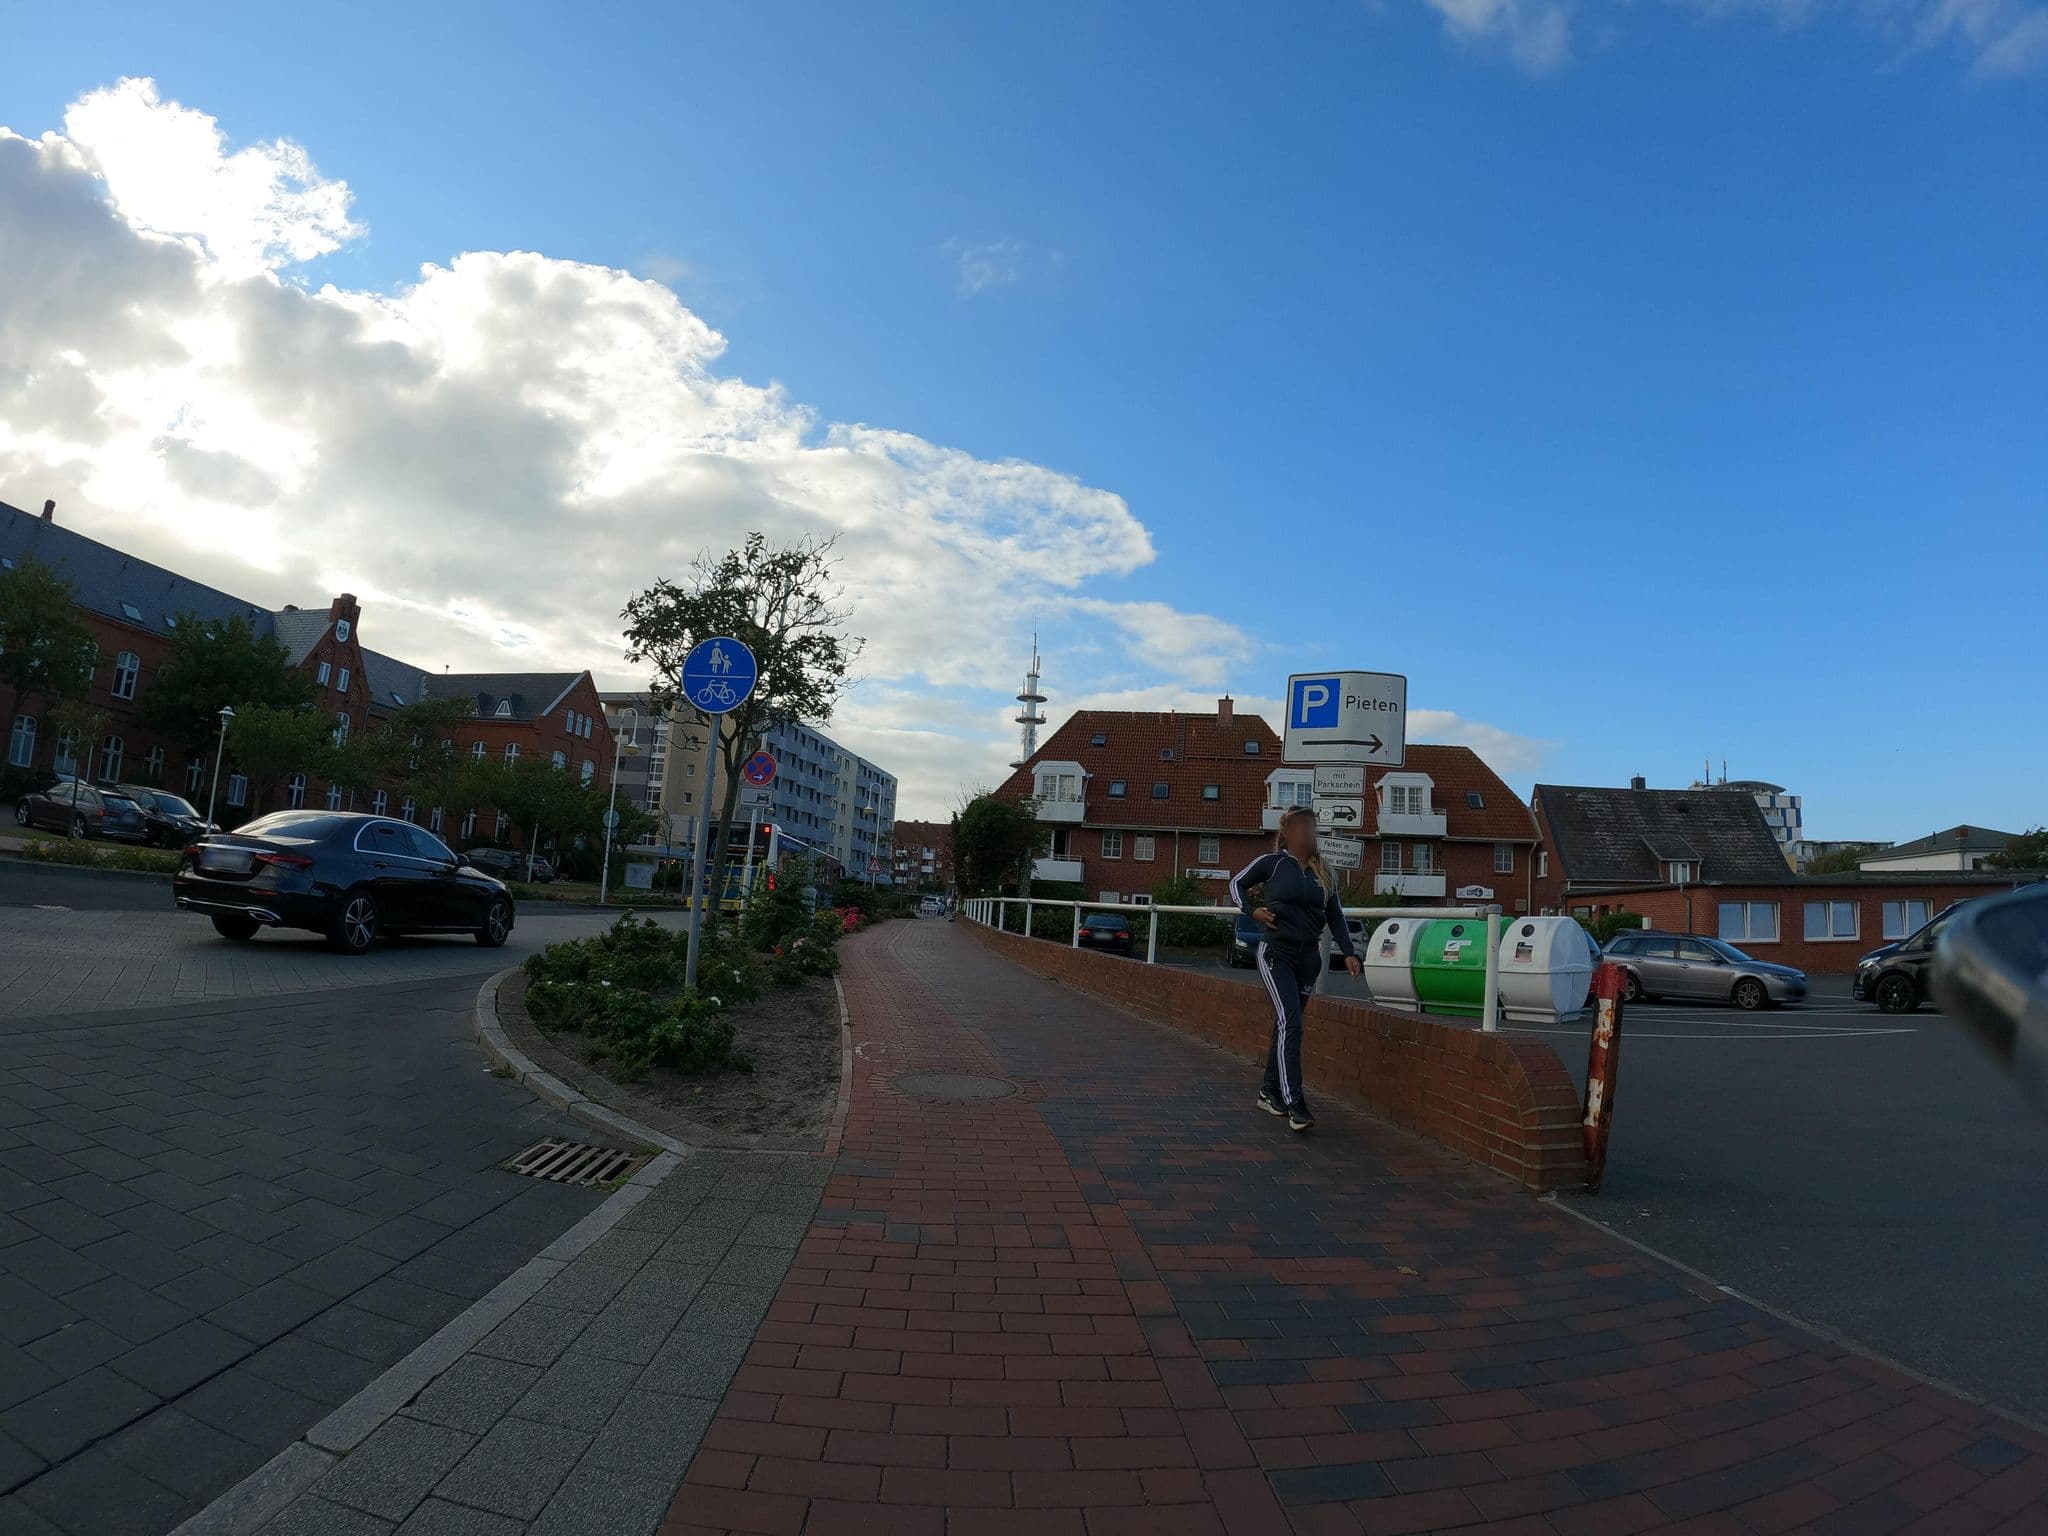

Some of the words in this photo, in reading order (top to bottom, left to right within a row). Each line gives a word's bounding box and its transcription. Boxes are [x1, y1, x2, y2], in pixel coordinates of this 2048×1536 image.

[1301, 684, 1329, 723] P
[1345, 695, 1398, 712] Pieten
[1323, 840, 1343, 849] Parken
